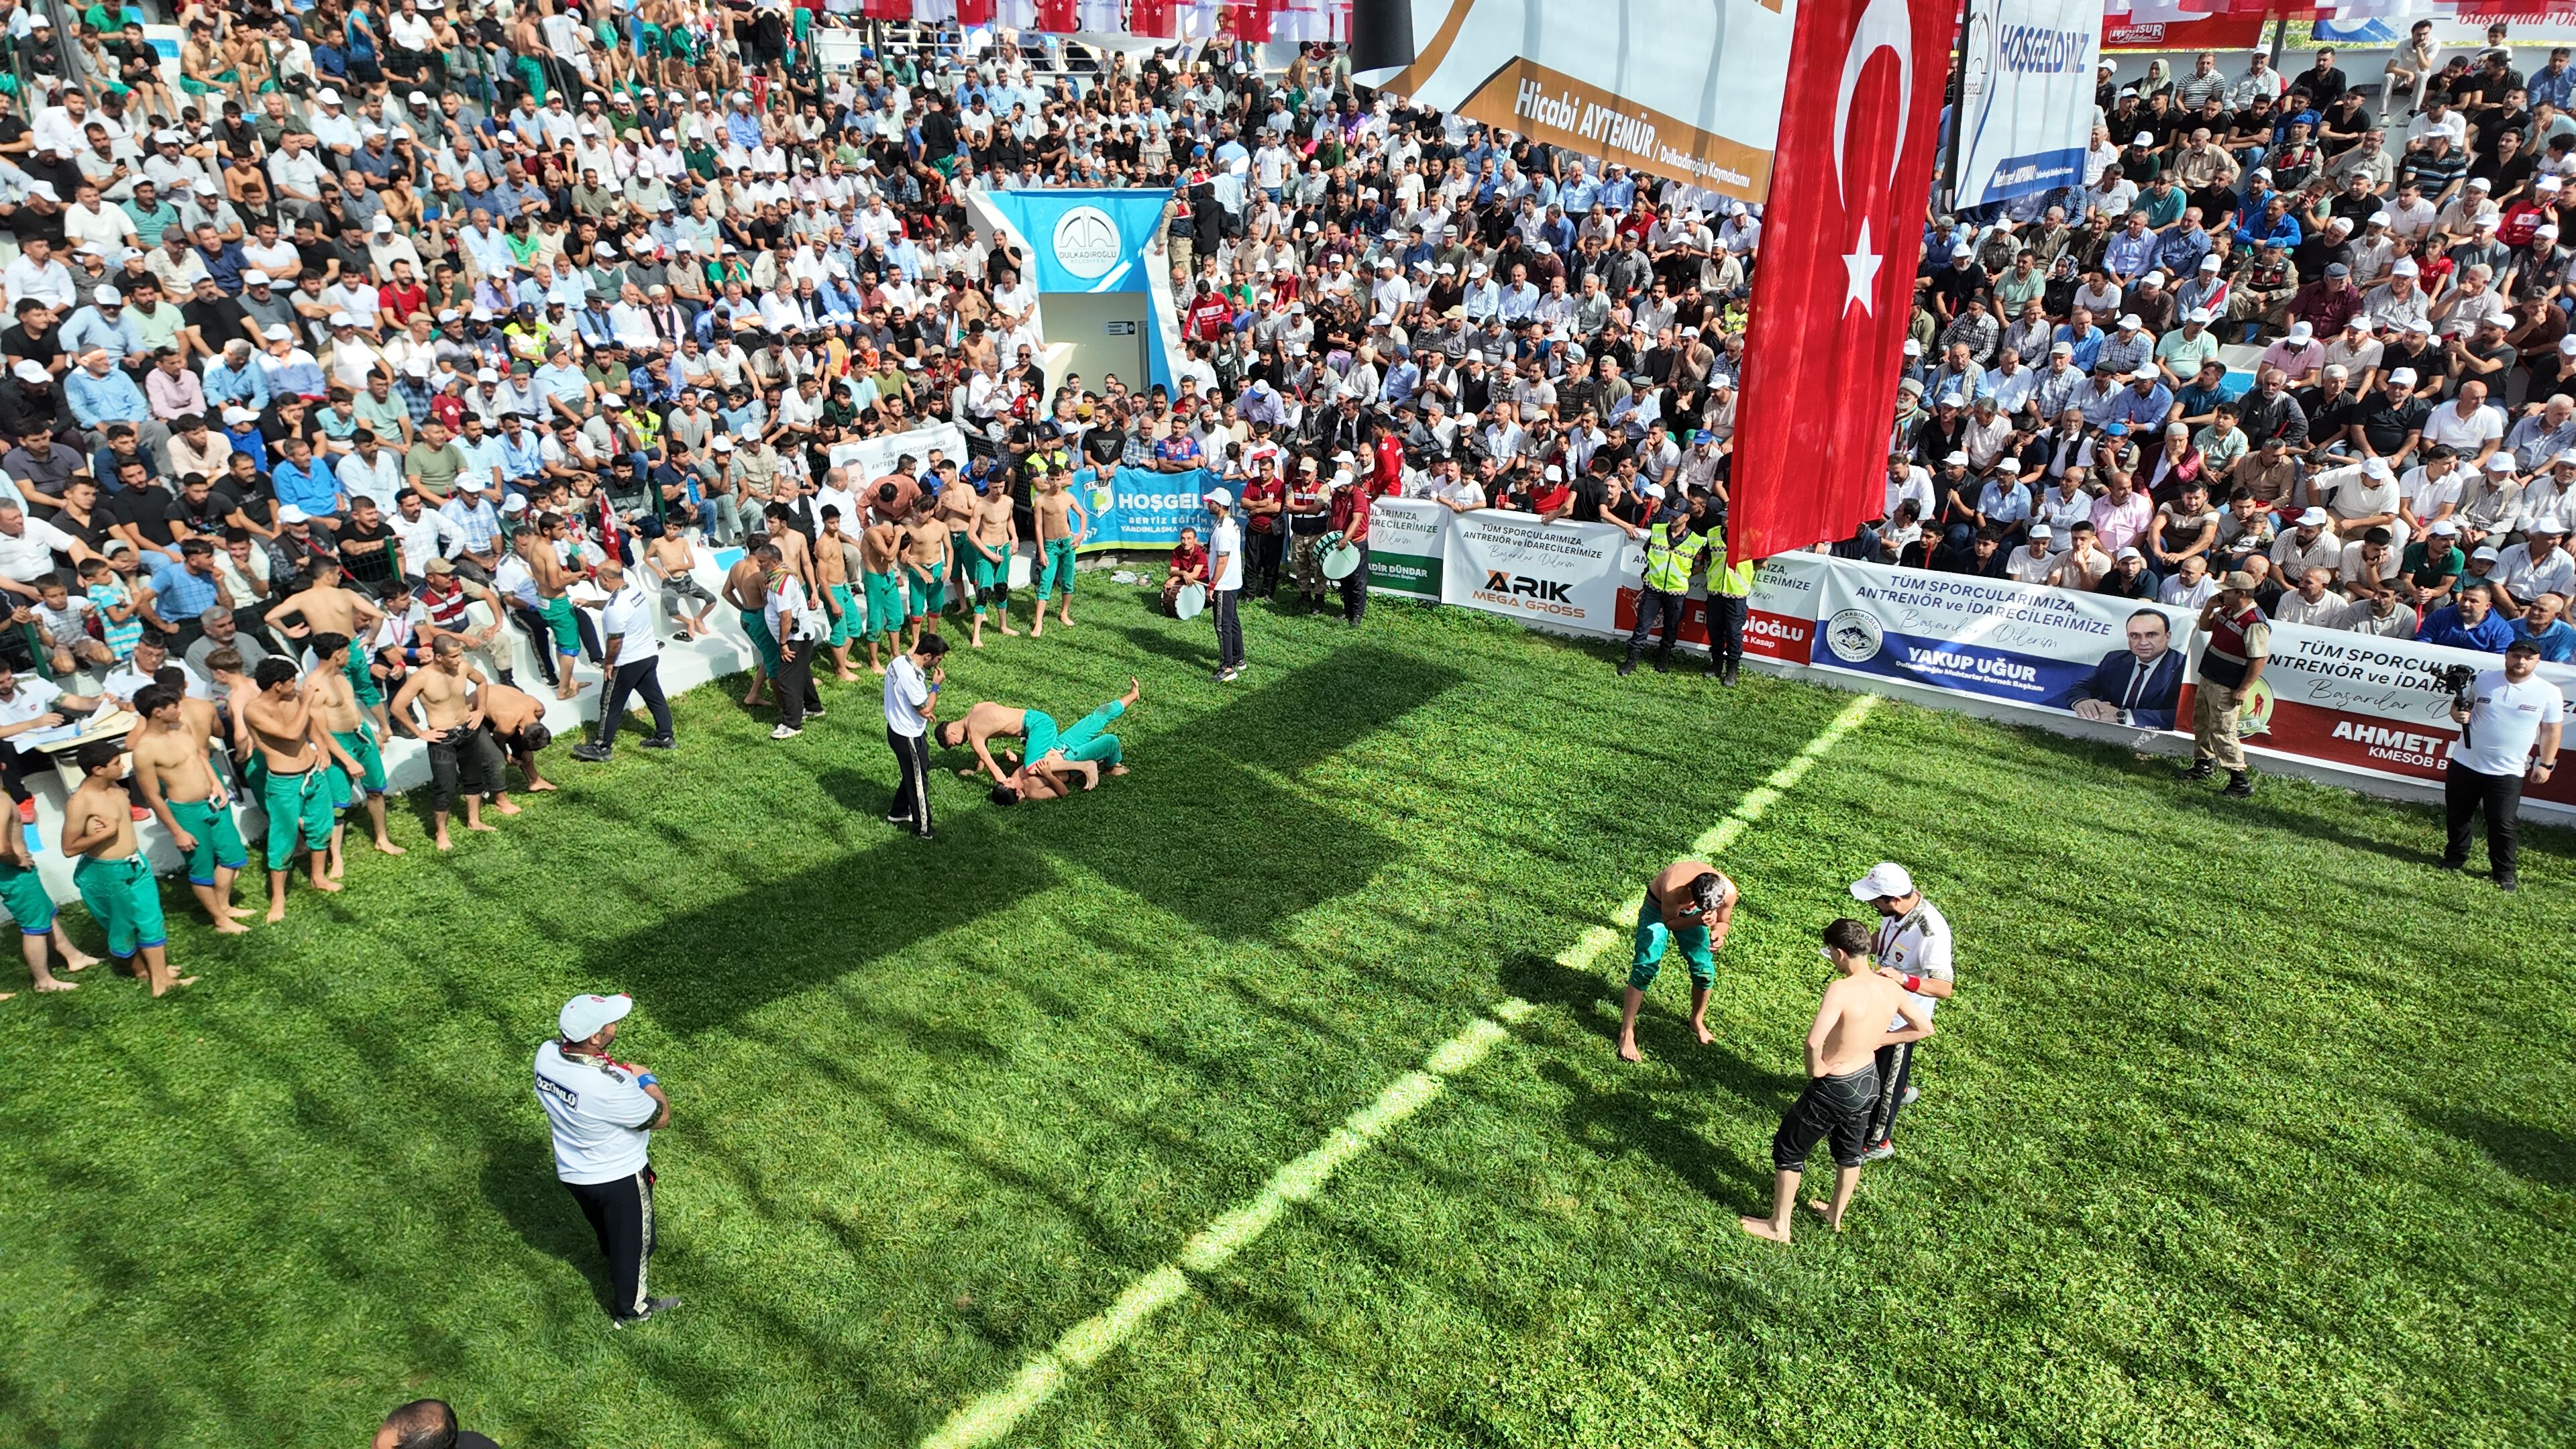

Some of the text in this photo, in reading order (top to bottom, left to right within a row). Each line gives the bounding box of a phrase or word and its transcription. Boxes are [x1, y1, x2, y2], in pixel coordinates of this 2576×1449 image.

[1515, 78, 1580, 132] Hicabi
[1578, 102, 1656, 158] AYTEMÜR
[1660, 145, 1707, 177] Dulkadiroğlu
[1708, 161, 1750, 188] Kaymakamı
[1059, 250, 1116, 258] DULKADİROĞLU
[1121, 525, 1178, 533] YARDIMLAŞMA
[1128, 515, 1167, 525] BERTİZ
[1172, 514, 1208, 525] EĞİTİM
[1368, 519, 1439, 533] ARECİLERİMİZE
[1482, 523, 1501, 534] TÜM
[1463, 531, 1511, 545] ANTRENÖR
[1523, 538, 1603, 559] İDARECİLERİMİZE
[1389, 564, 1428, 578] DÜNDAR
[1752, 570, 1811, 591] İLERİMİZE
[1485, 572, 1574, 604] ARIK
[1891, 575, 2080, 616] TÜM SPORCULARIMIZA,
[1472, 590, 1586, 619] MEGA GROSS
[1856, 586, 2112, 636] ANTRENÖR ve İDARECİLERİMİZE
[1750, 636, 1775, 649] Kasap
[1992, 623, 2057, 648] Dilerim
[2299, 640, 2345, 659] TÜM
[1895, 661, 2045, 692] Dulkadiroğlu Muhtarlar Dernek Başkanı
[1909, 647, 2037, 682] YAKUP UĞUR
[2267, 653, 2364, 680] NTRENÖR
[2368, 672, 2390, 684] ve
[2308, 679, 2414, 710] Başarılar
[2332, 720, 2443, 755] AHMET
[2369, 746, 2434, 768] KMESOB
